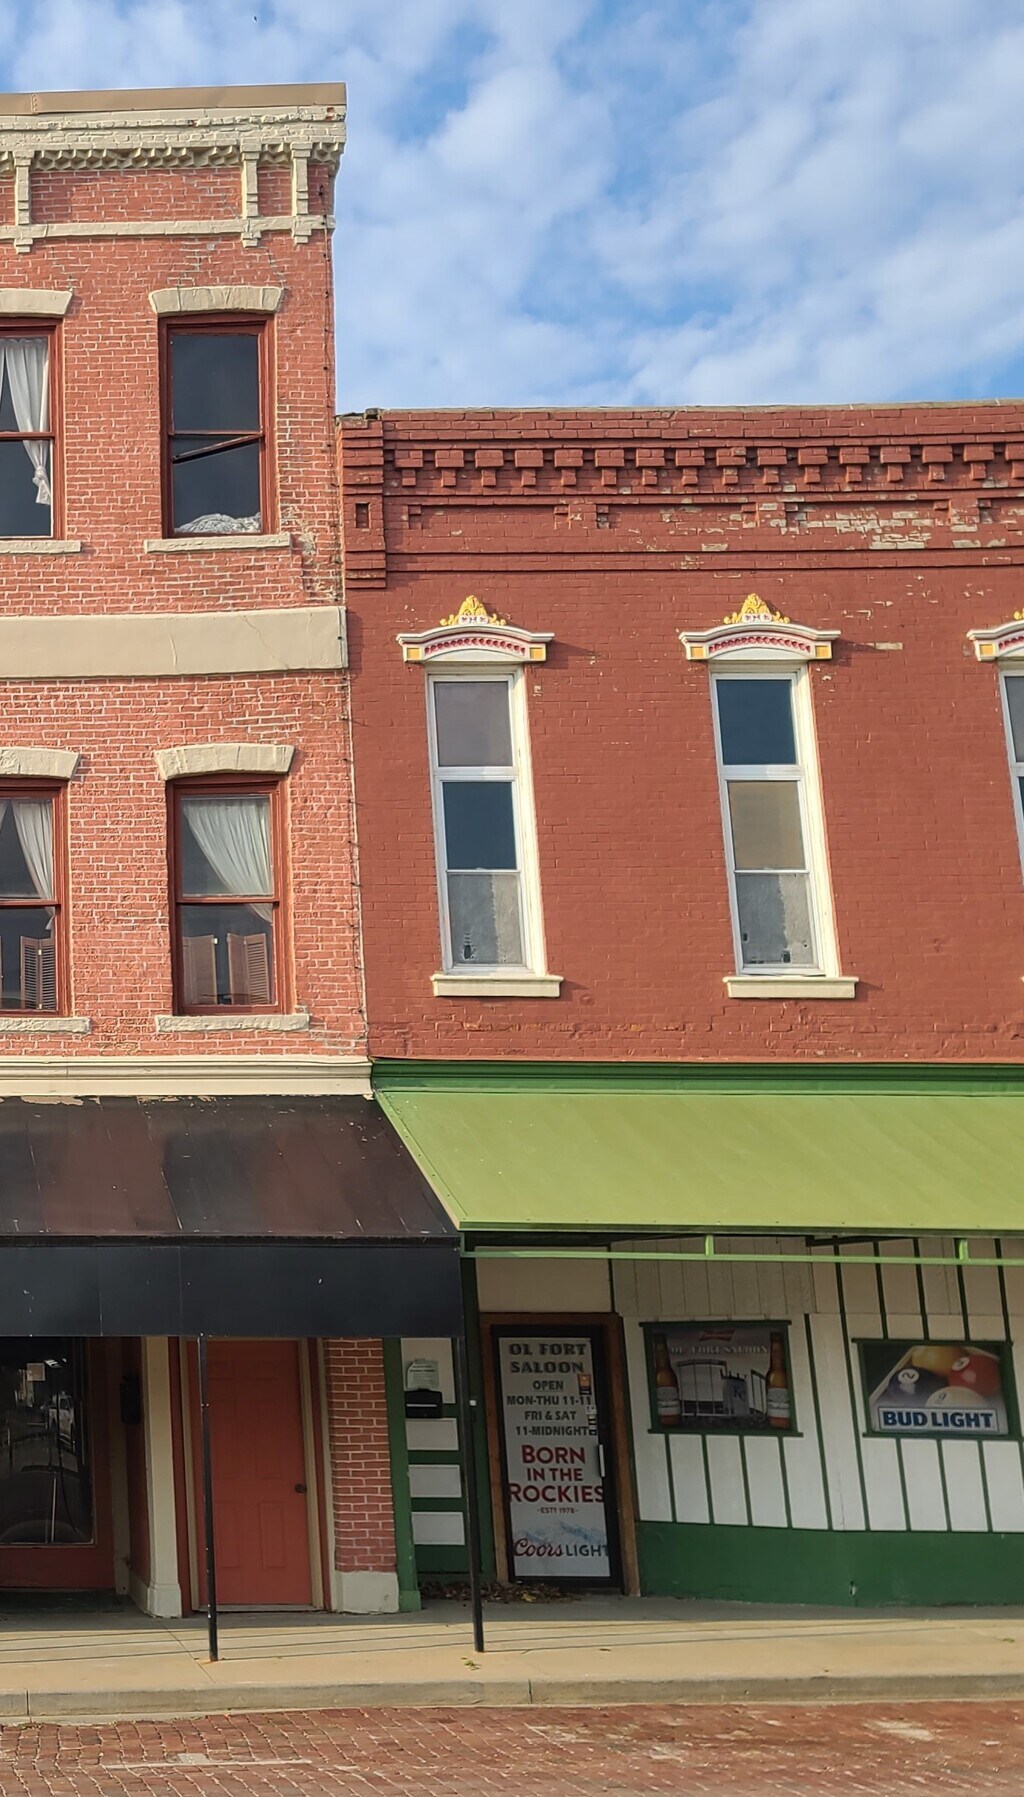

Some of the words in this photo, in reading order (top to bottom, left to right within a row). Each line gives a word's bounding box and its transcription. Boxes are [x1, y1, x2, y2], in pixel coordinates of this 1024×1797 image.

[509, 1343, 533, 1355] OL
[538, 1343, 587, 1355] FORT
[510, 1361, 584, 1373] SALOON
[532, 1380, 564, 1390] OPEN
[506, 1395, 560, 1405] MON-THU
[563, 1395, 591, 1405] 11-11
[524, 1410, 542, 1420] FRI
[545, 1411, 553, 1420] &
[555, 1410, 577, 1420] SAT
[882, 1411, 928, 1426] BUD
[931, 1412, 993, 1428] LIGHT
[516, 1426, 589, 1436] 11-MIDNIGHT
[521, 1444, 586, 1464] BORN
[527, 1468, 545, 1481] IN
[549, 1468, 583, 1481] THE
[508, 1483, 604, 1503] ROCKIES
[514, 1538, 564, 1557] Coors
